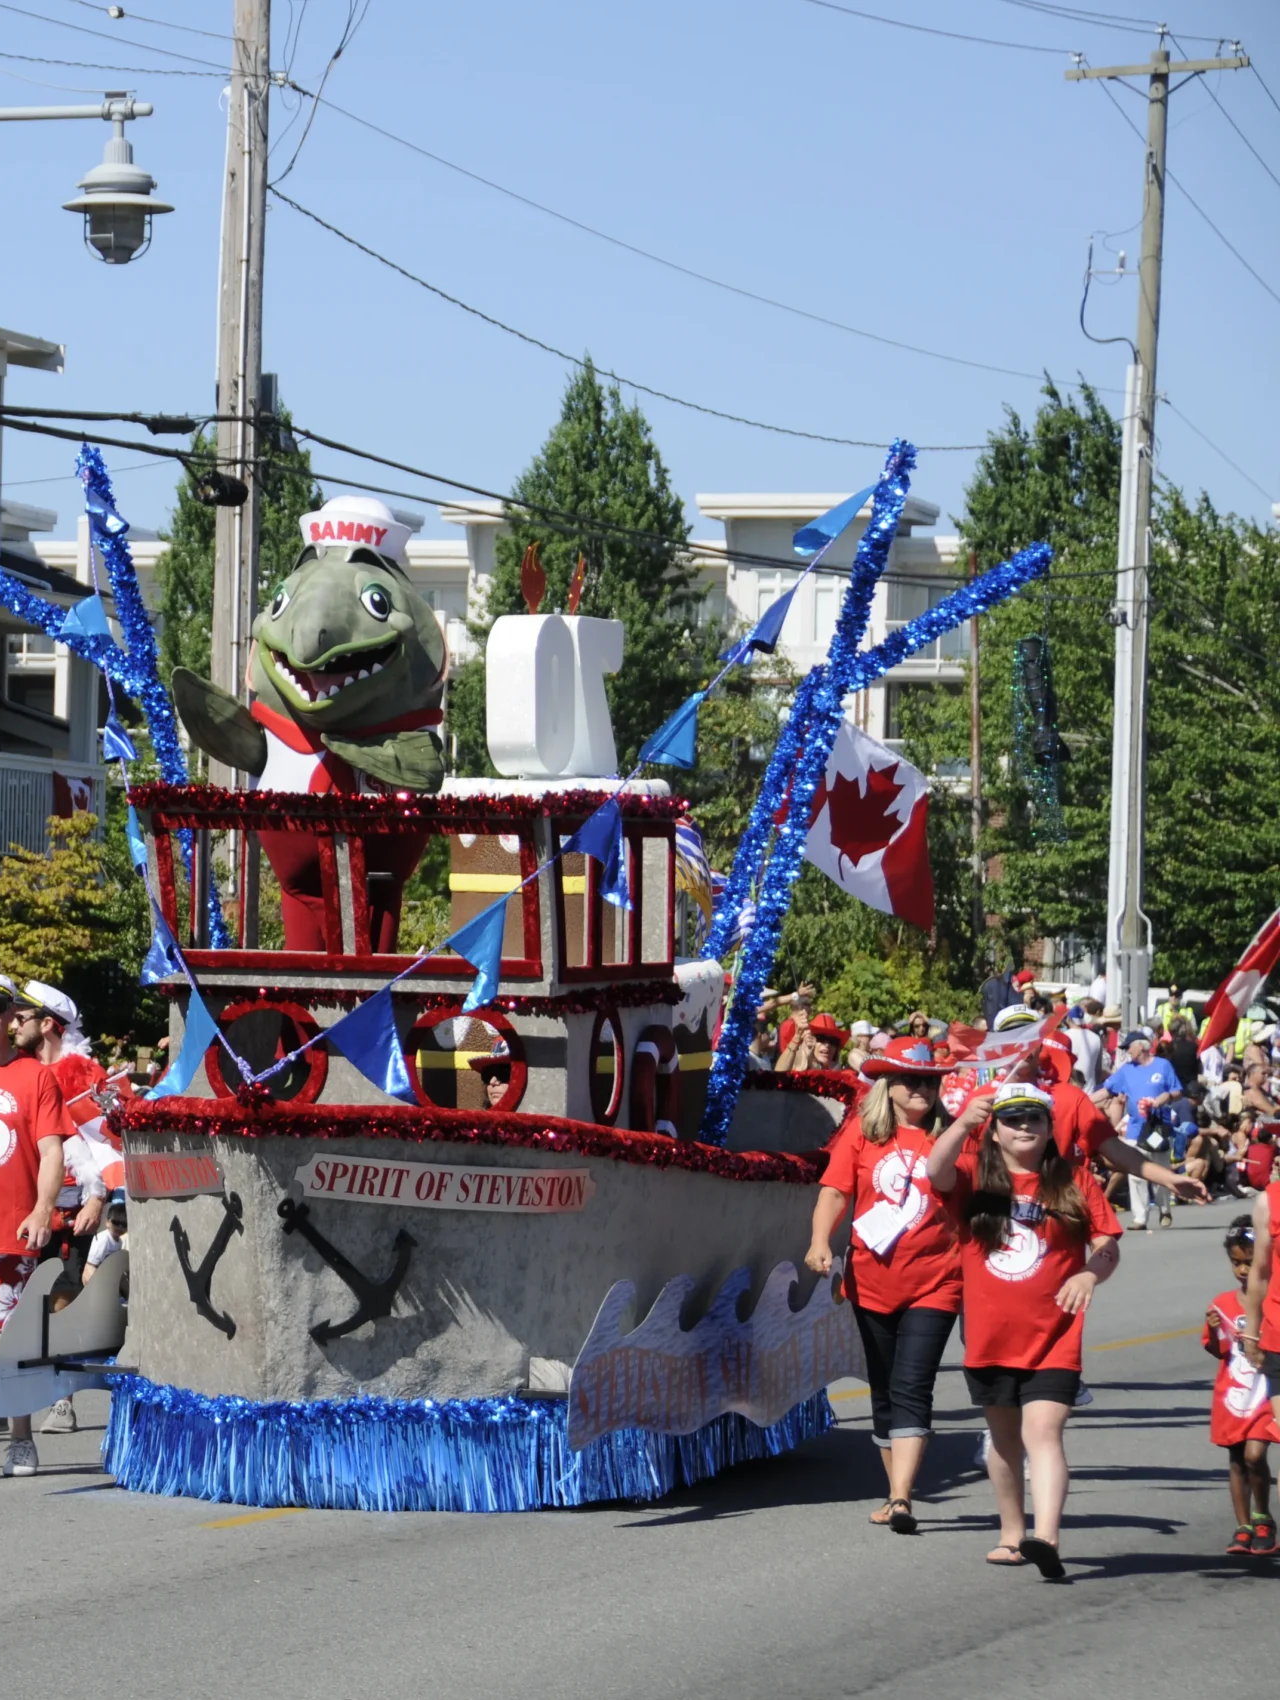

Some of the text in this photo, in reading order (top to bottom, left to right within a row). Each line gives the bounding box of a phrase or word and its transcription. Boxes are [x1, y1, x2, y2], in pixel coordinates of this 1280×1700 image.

[310, 520, 388, 547] SAMMY
[310, 1160, 587, 1208] SPIRIT OF STEVESTON
